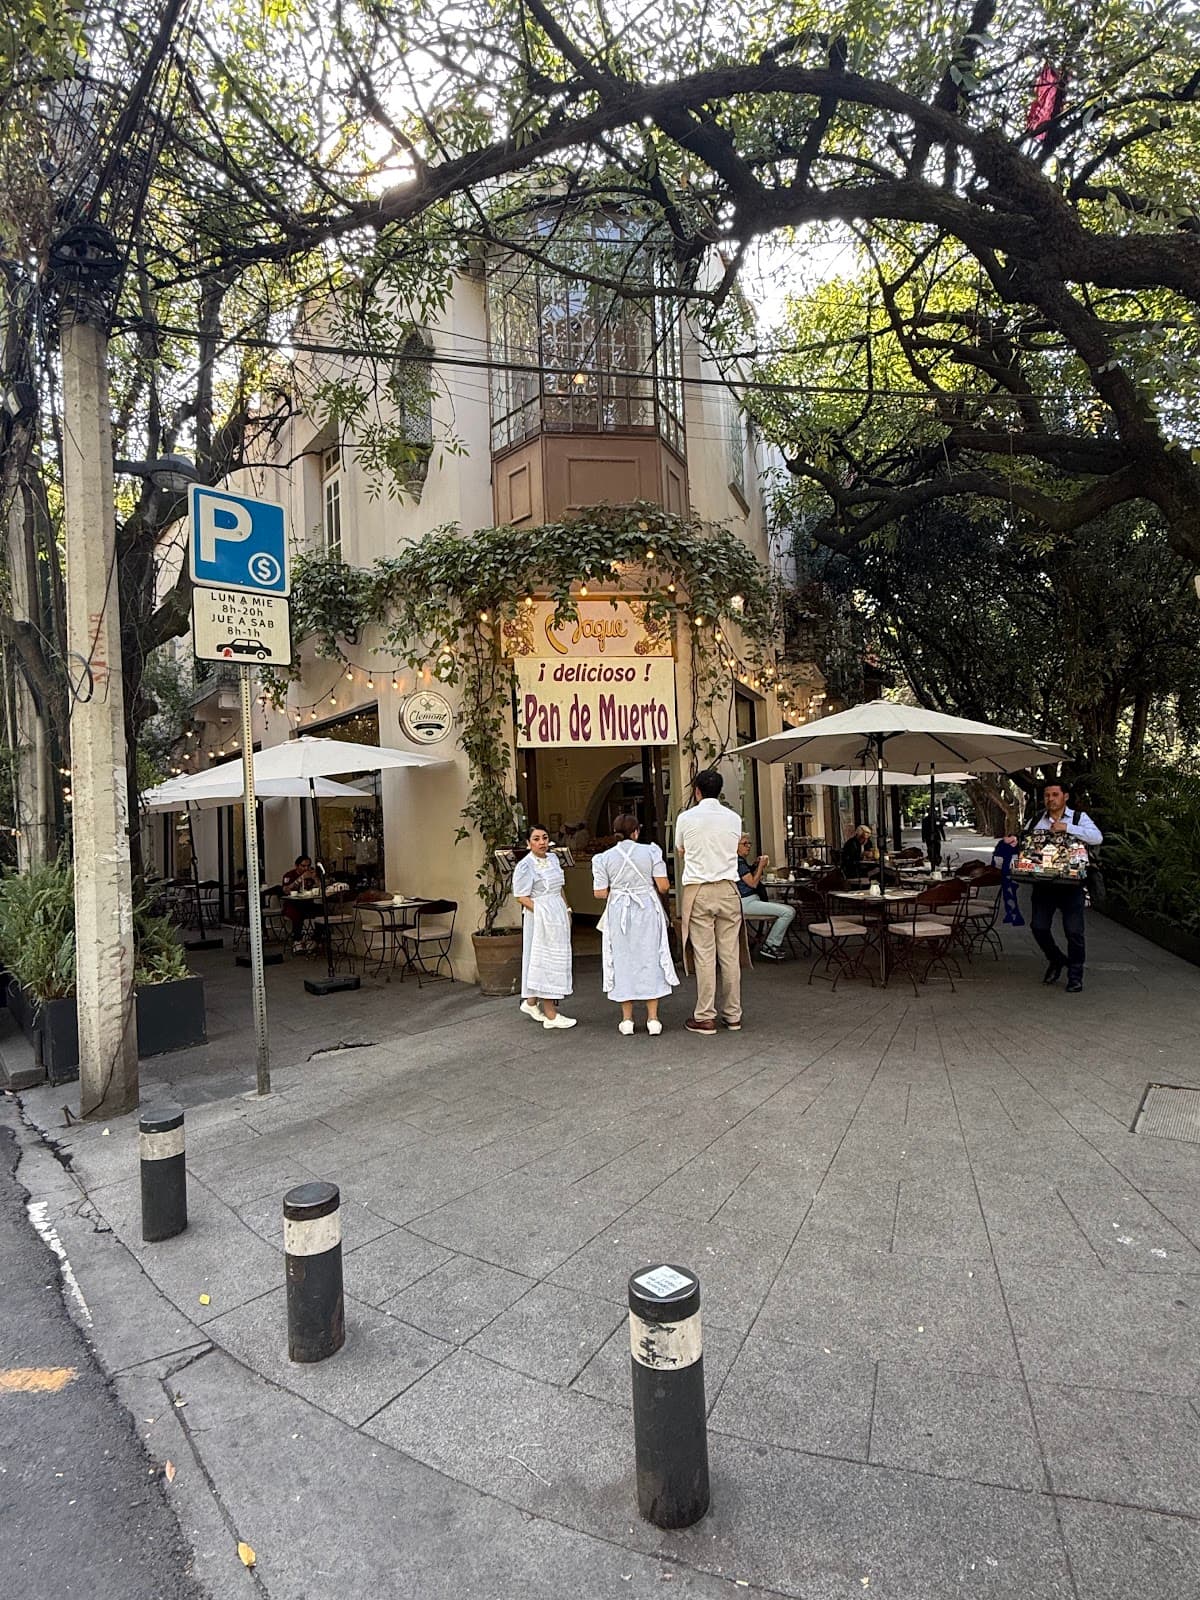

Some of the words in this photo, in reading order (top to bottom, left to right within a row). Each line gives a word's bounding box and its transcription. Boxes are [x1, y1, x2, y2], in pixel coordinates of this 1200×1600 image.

[199, 493, 253, 563] P
[210, 592, 235, 604] LUN
[239, 595, 248, 605] A
[252, 598, 273, 608] MIE
[222, 604, 264, 617] 8h-20h
[211, 614, 233, 625] JUE
[238, 616, 246, 626] A
[251, 618, 274, 628] SAB
[227, 626, 260, 638] 8h-1h
[553, 663, 636, 682] delicioso
[524, 694, 561, 742] Pan
[569, 693, 592, 742] de
[599, 693, 669, 741] Muerto
